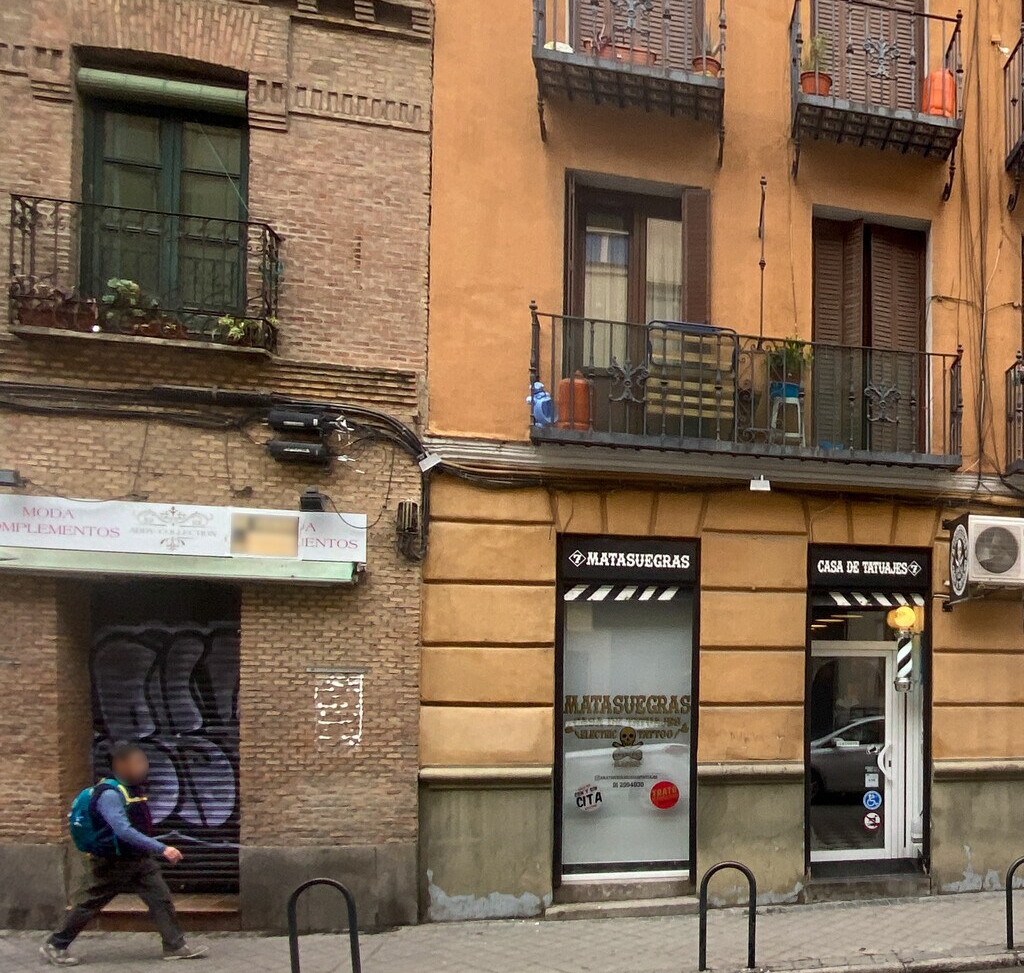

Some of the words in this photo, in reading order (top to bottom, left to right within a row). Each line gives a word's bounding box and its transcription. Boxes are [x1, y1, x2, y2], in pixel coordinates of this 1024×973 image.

[22, 506, 75, 519] MODA
[0, 521, 121, 538] MPLEMENTOS
[586, 551, 690, 569] MATASUEGRAS
[817, 559, 844, 574] CASA
[846, 560, 860, 574] DE
[862, 561, 908, 575] TATUAJES
[563, 694, 691, 715] MATASUEGRAS
[576, 791, 603, 808] CITA
